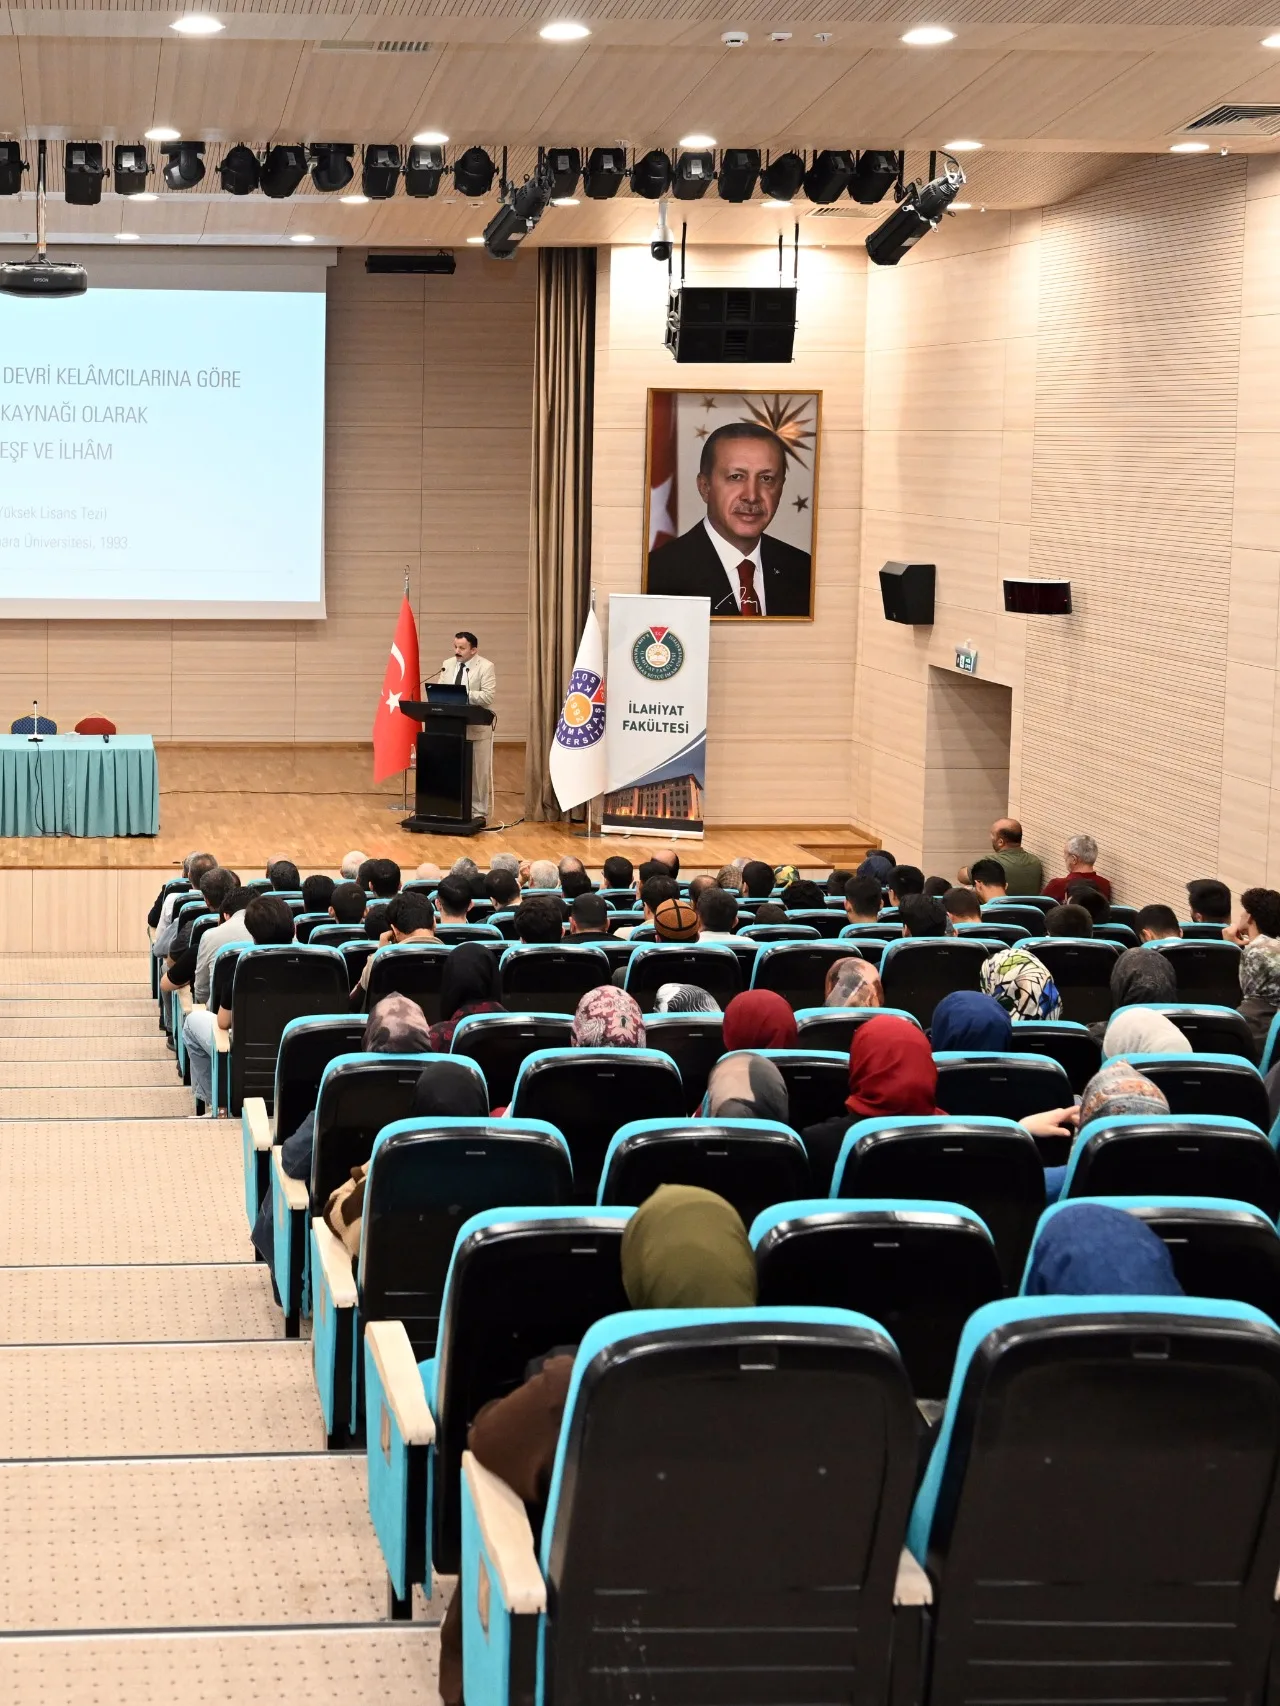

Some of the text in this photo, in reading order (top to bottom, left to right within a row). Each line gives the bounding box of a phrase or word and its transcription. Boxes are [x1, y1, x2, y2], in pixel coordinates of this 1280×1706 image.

[3, 364, 51, 385] DEVRİ
[56, 364, 192, 387] KELÂMCILARINA
[197, 367, 241, 388] GÖRE
[1, 401, 76, 422] KAYNAĞI
[82, 405, 149, 423] OLARAK
[33, 442, 54, 459] VE
[59, 438, 113, 460] İLHÂM
[40, 506, 78, 520] Lisans
[81, 506, 108, 521] Tezi)
[628, 700, 685, 716] İLAHİYAT
[622, 718, 689, 734] FAKÜLTESİ
